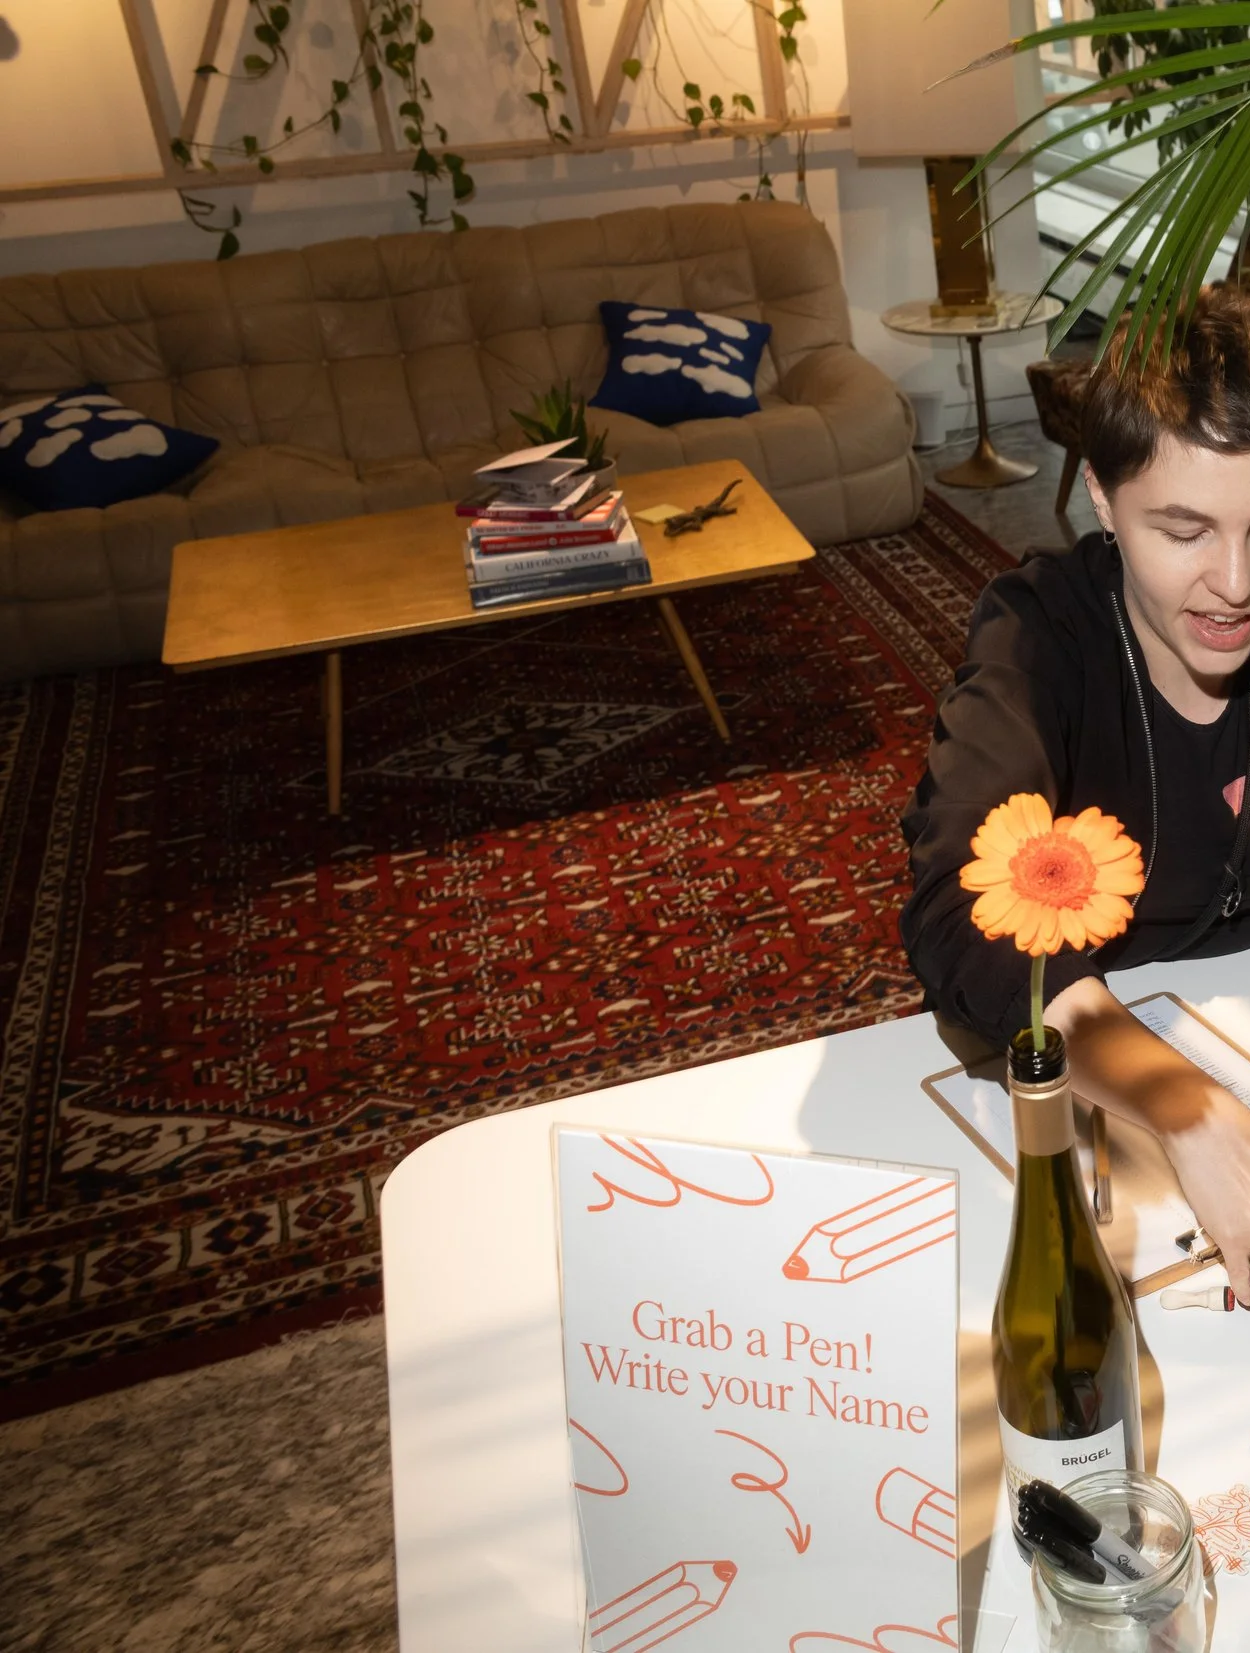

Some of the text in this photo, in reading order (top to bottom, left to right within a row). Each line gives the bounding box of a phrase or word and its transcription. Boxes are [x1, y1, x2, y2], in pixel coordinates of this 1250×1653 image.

[504, 549, 610, 573] CALIFORNIA CRAZY
[631, 1300, 873, 1374] Grab a Pen!
[580, 1342, 929, 1434] Write your Name
[1061, 1447, 1112, 1467] BRÜGEL
